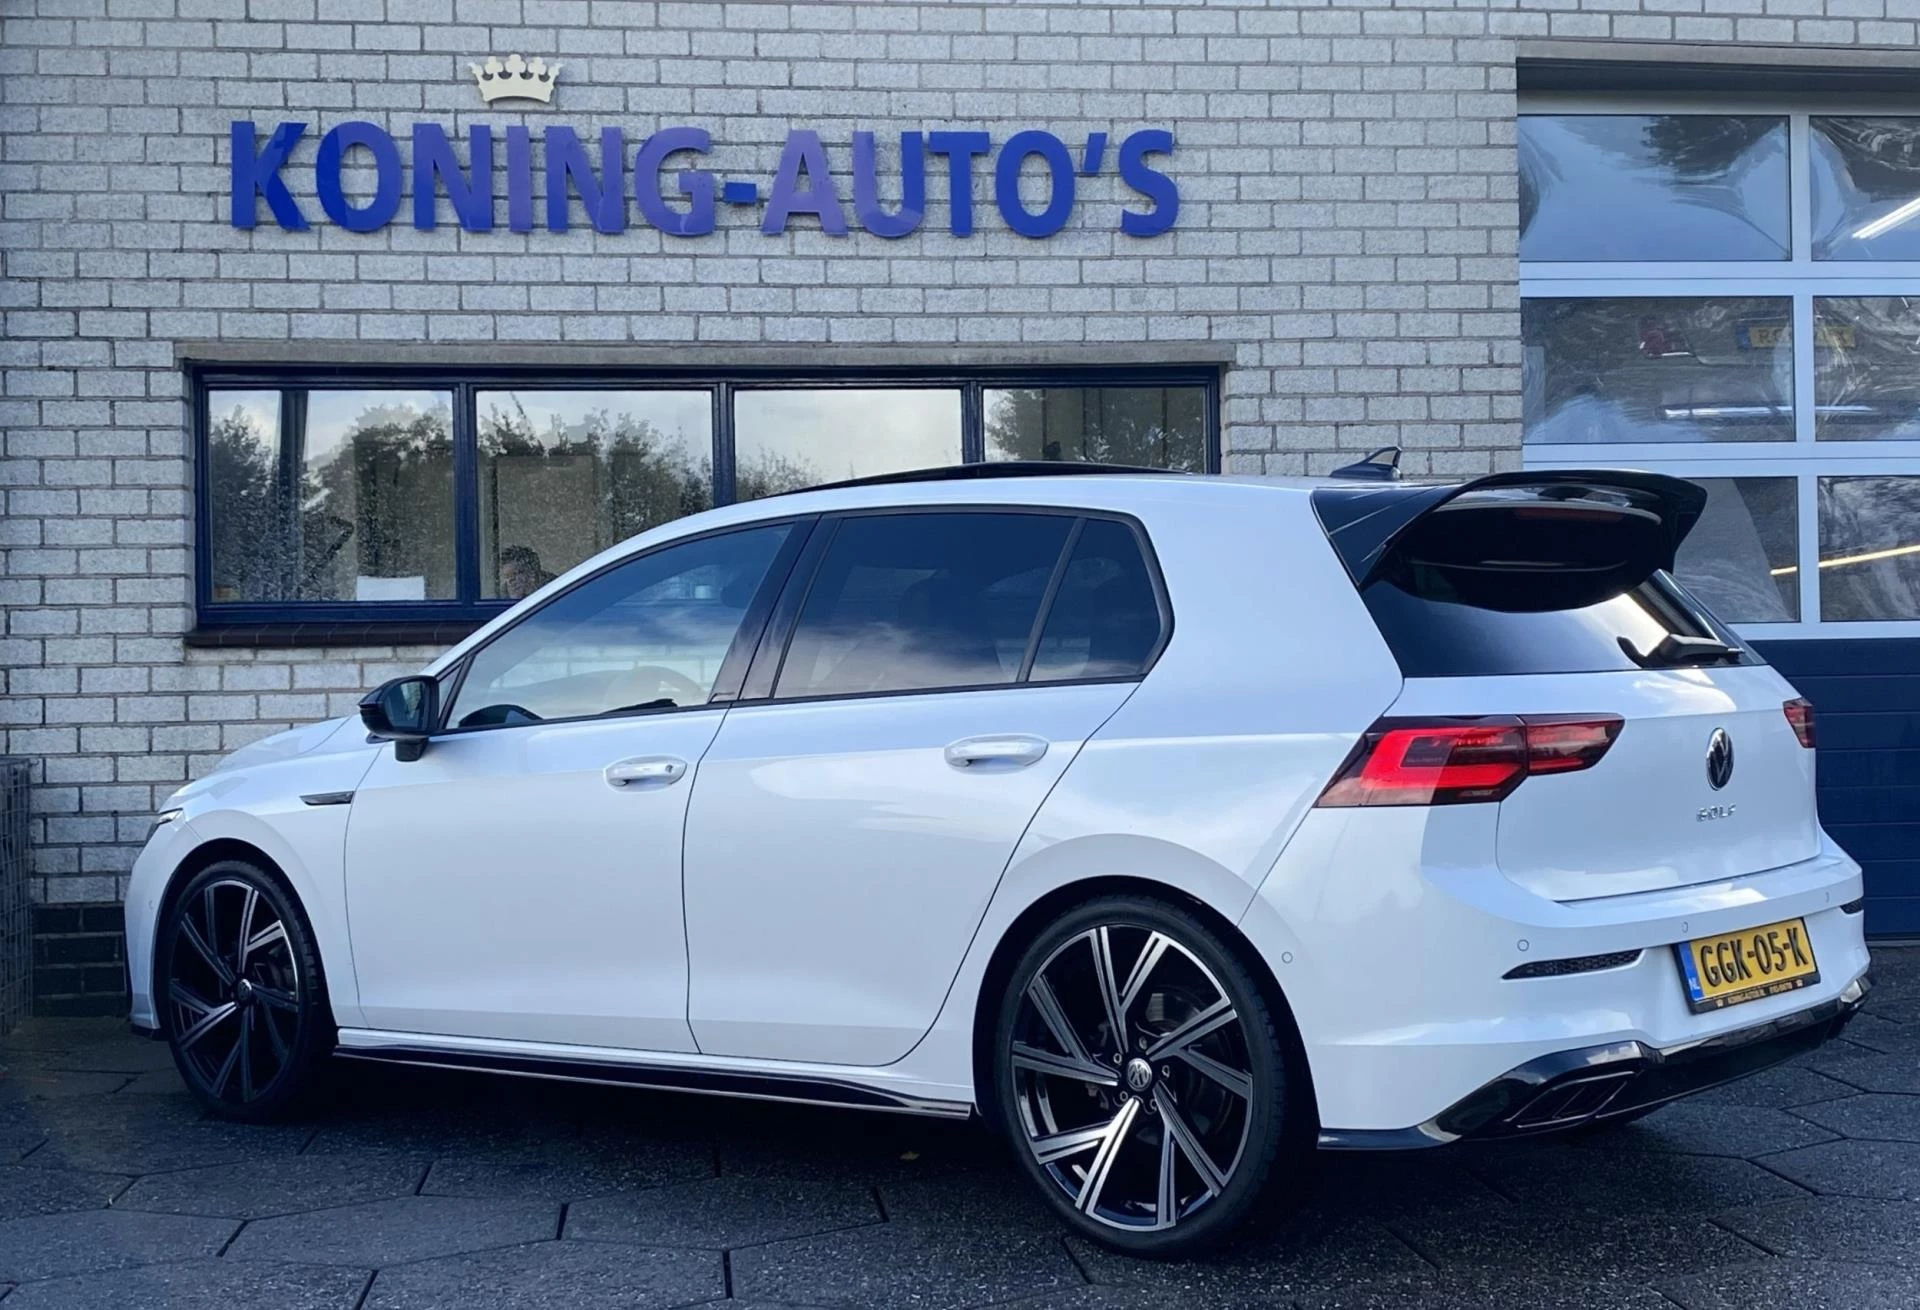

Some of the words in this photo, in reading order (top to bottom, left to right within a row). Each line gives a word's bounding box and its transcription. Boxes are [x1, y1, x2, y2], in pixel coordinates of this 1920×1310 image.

[230, 119, 1179, 239] KONING-AUTO'S
[1696, 803, 1737, 822] GOLF
[1700, 927, 1808, 987] GGK-05-K
